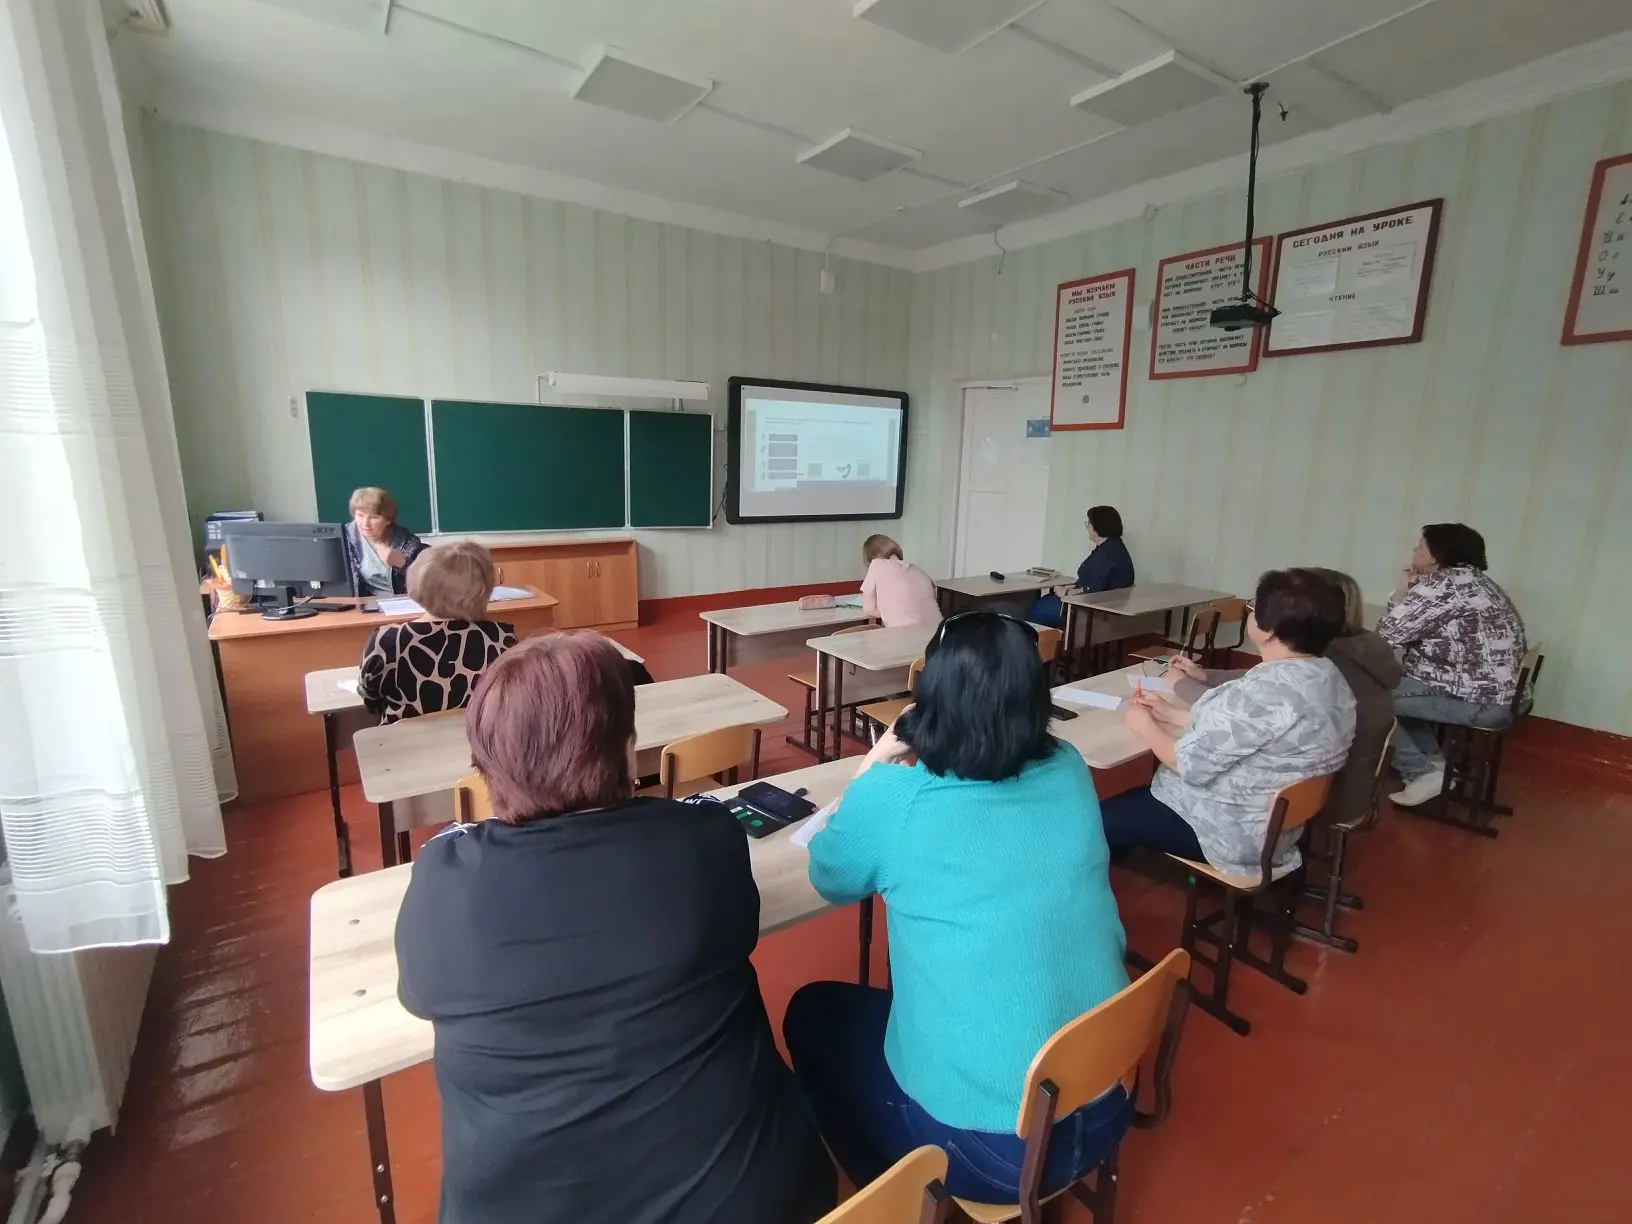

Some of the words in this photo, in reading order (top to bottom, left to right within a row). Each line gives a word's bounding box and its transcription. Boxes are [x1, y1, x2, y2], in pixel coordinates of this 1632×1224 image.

[1292, 230, 1345, 249] СЕГОДНЯ
[1350, 226, 1365, 237] НА
[1372, 215, 1414, 232] УРОКЕ
[1318, 246, 1352, 257] РУССКИЙ
[1357, 240, 1380, 250] ЯЗЫК
[1185, 260, 1210, 271] ЧАСТИ
[1215, 254, 1236, 265] РЕЧИ
[1086, 283, 1116, 294] ИЗУЧАЕМ
[1098, 291, 1116, 300] ЯЗЫК
[1328, 292, 1356, 302] ЧТЕНИЕ
